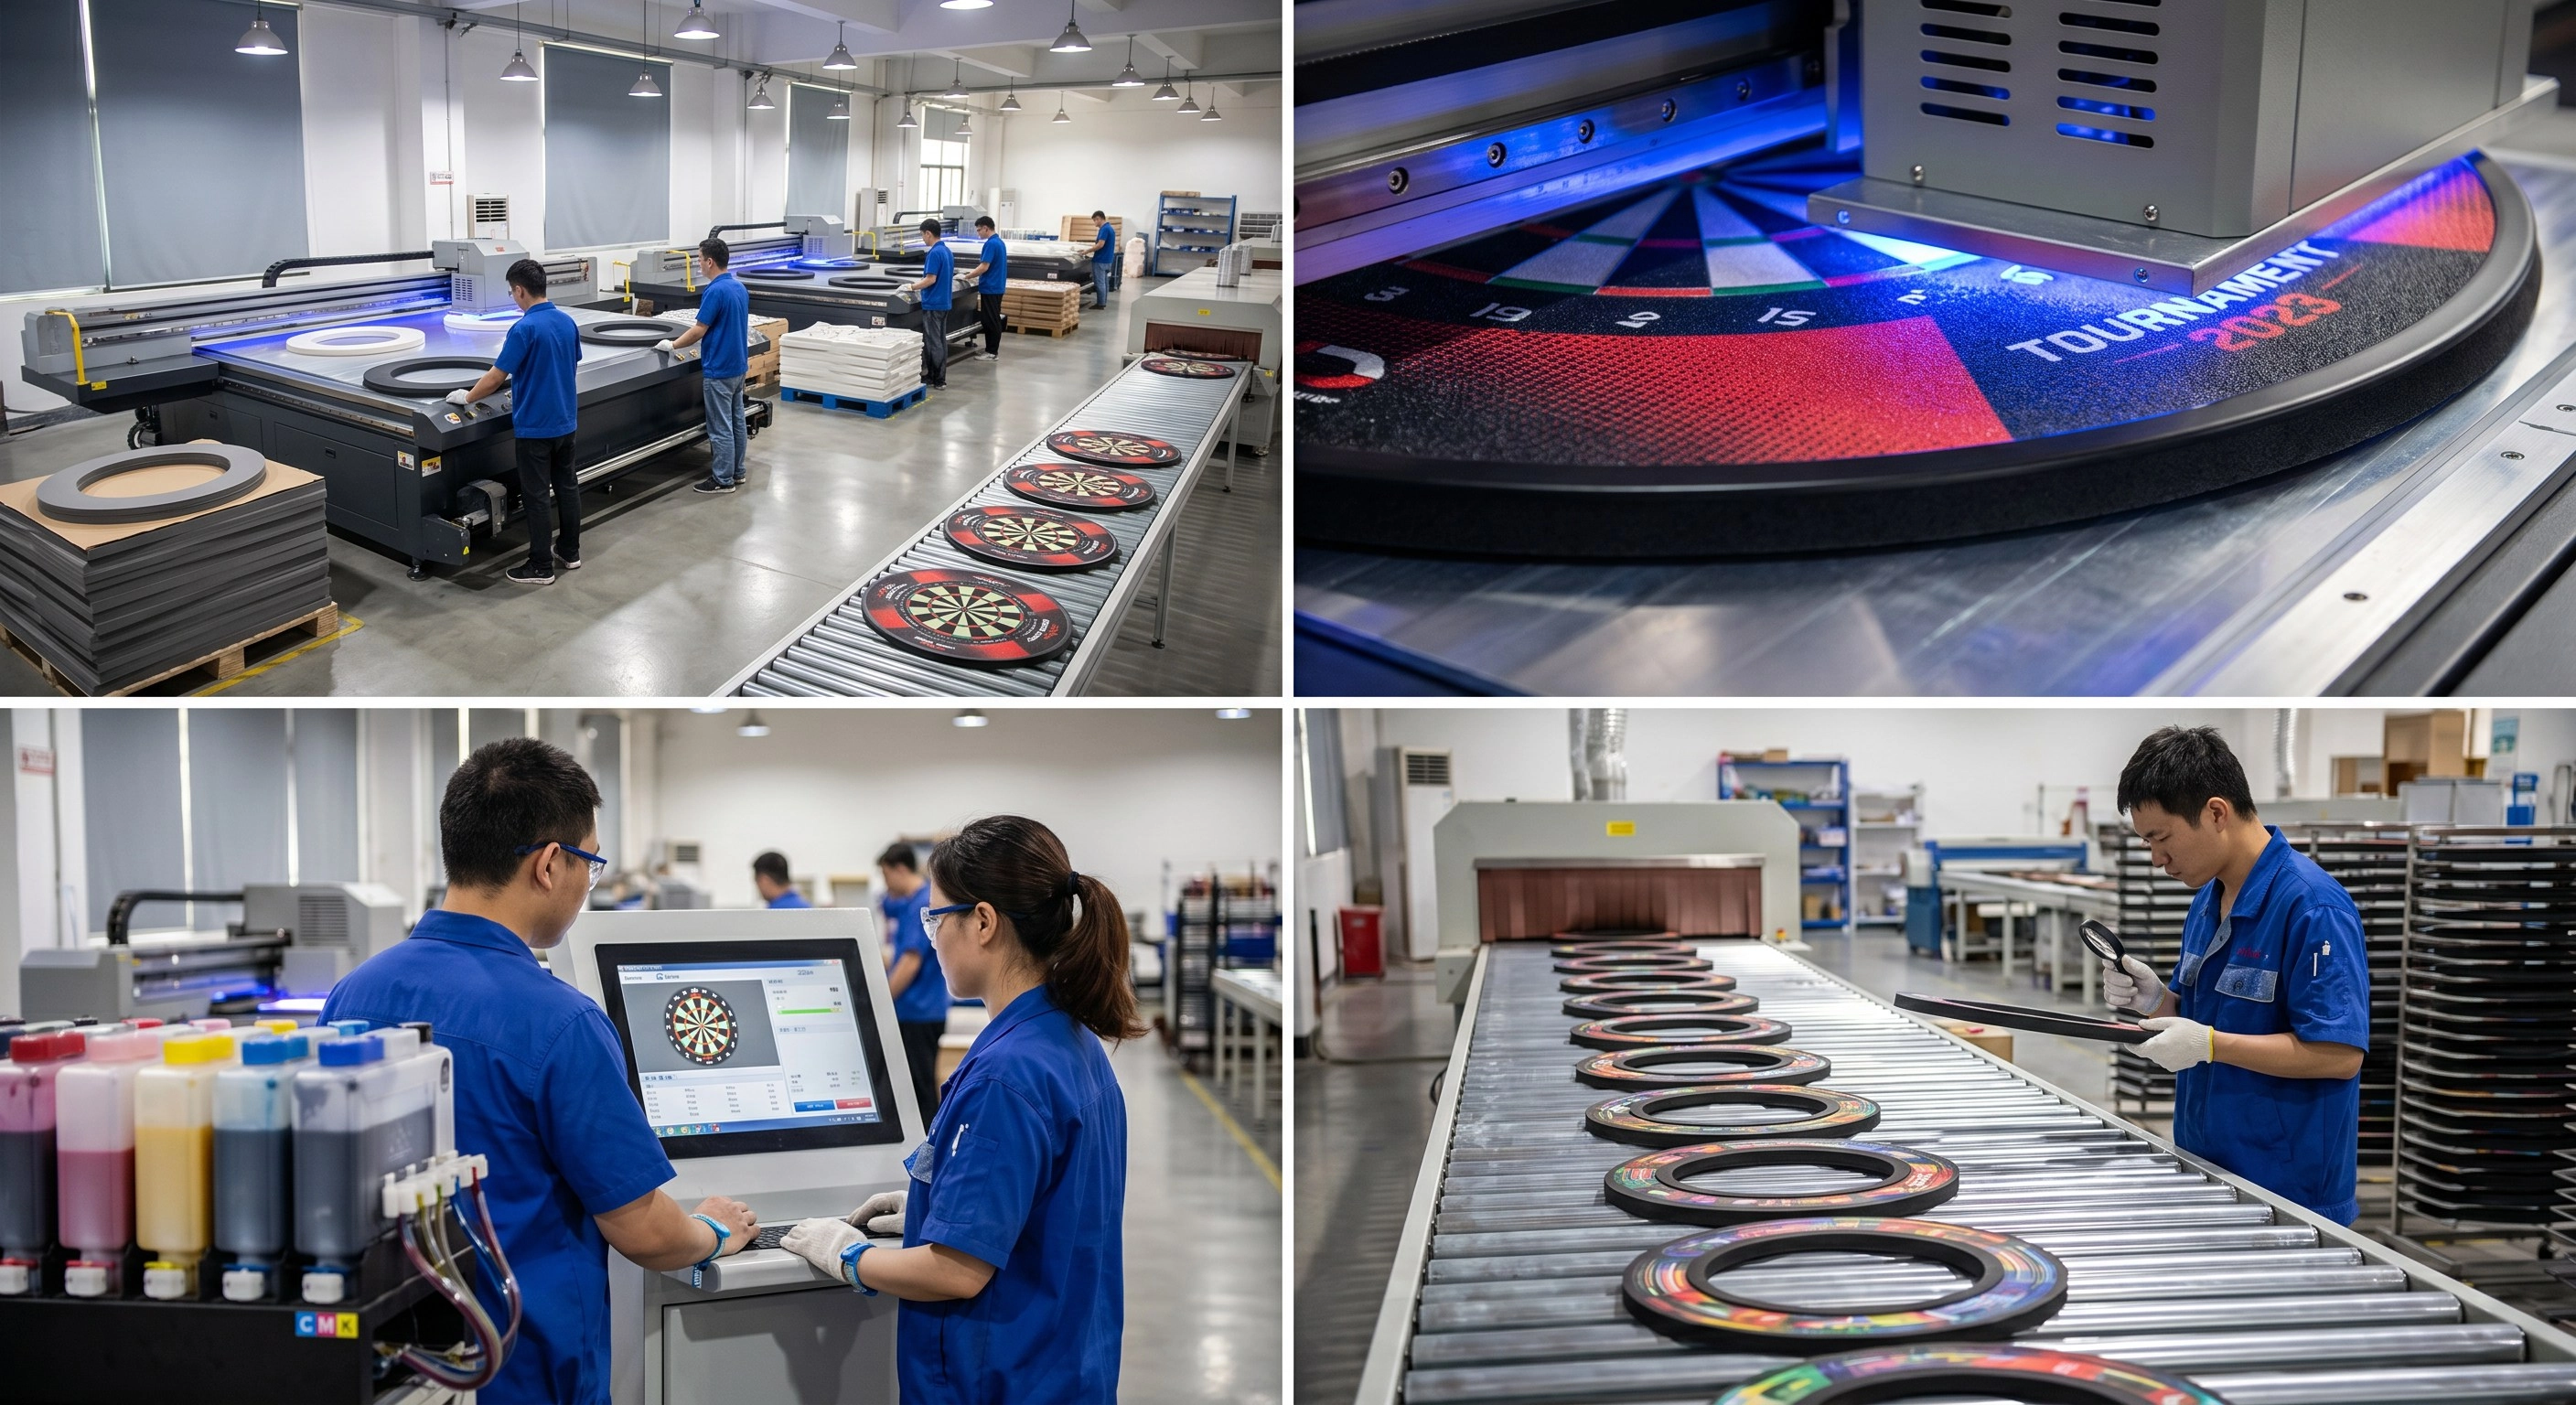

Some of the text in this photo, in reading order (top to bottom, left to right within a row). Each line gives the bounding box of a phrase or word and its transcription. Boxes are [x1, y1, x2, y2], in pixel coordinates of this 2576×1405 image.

[1469, 302, 1532, 322] 19
[2005, 241, 2340, 362] TOURNAMENT
[2187, 293, 2342, 351] 2023
